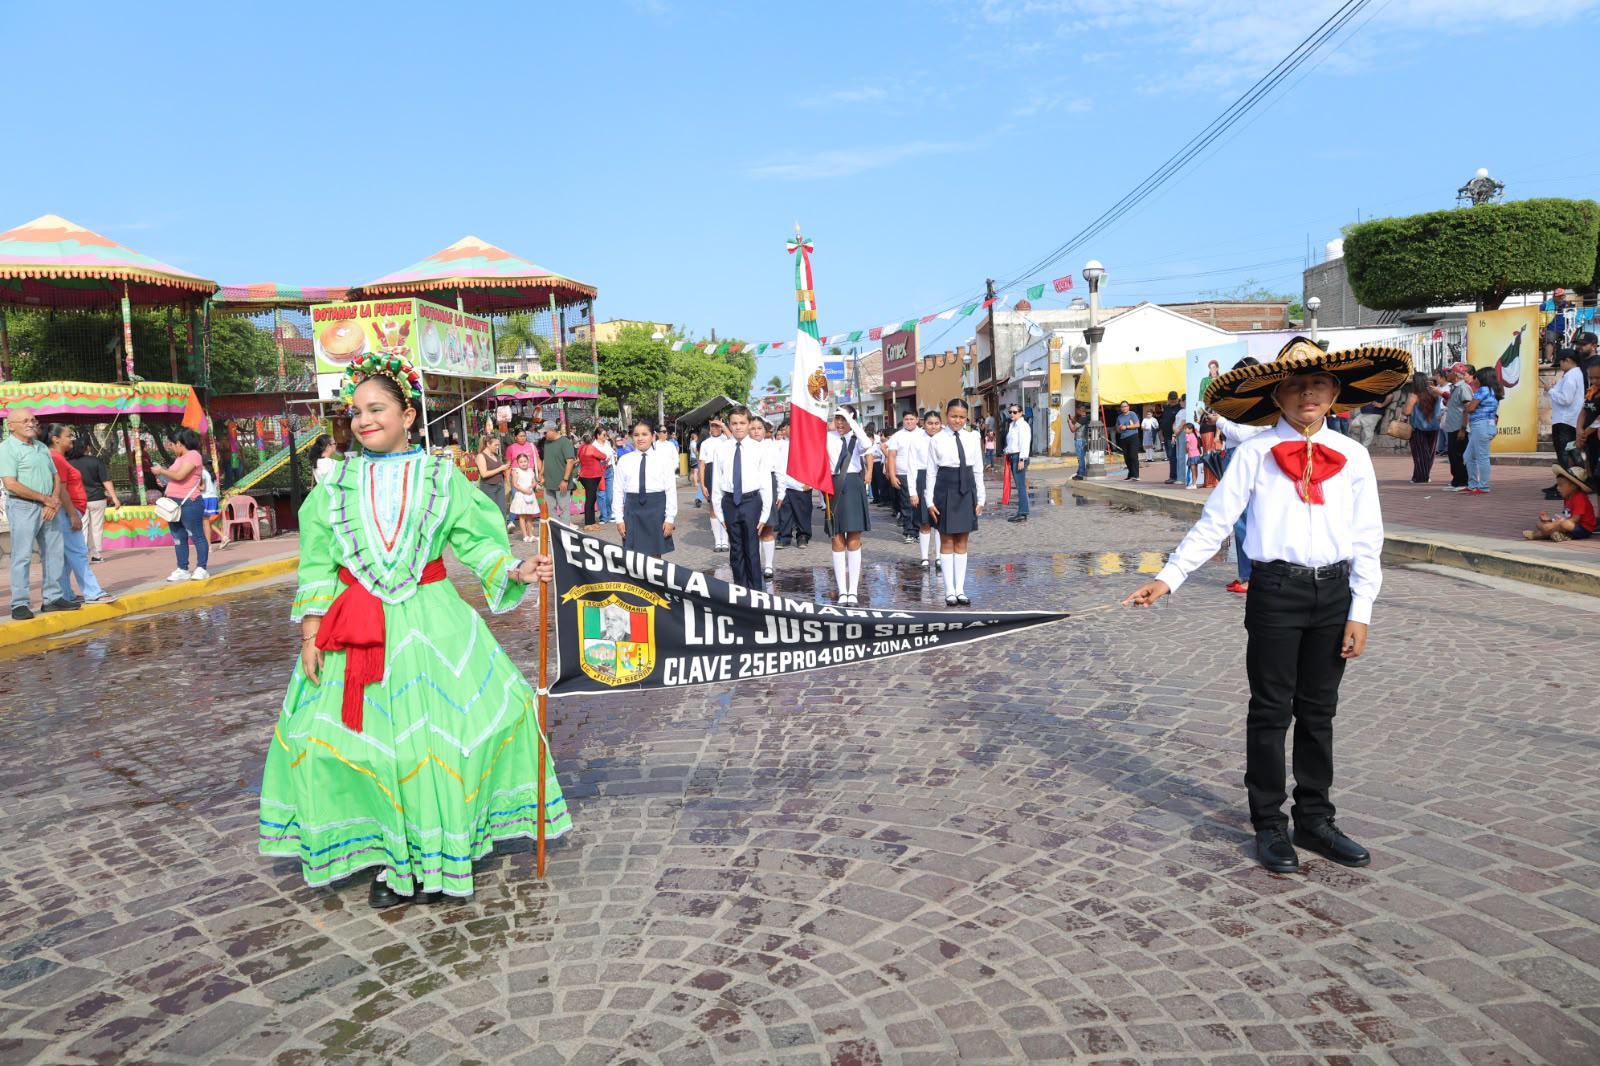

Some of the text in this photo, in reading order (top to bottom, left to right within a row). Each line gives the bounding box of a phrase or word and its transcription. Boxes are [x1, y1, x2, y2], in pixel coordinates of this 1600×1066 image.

[313, 301, 413, 322] BOTANAS LA FUENTE
[419, 304, 489, 334] BOTANAS LA FUENTE
[1479, 319, 1486, 327] 16
[886, 336, 908, 361] Comex
[560, 529, 915, 618] ESCUELA PRIMARIA
[615, 599, 648, 612] PRIMARIA
[754, 614, 863, 645] JUSTO
[663, 655, 732, 686] CLAVE
[914, 633, 940, 648] 014
